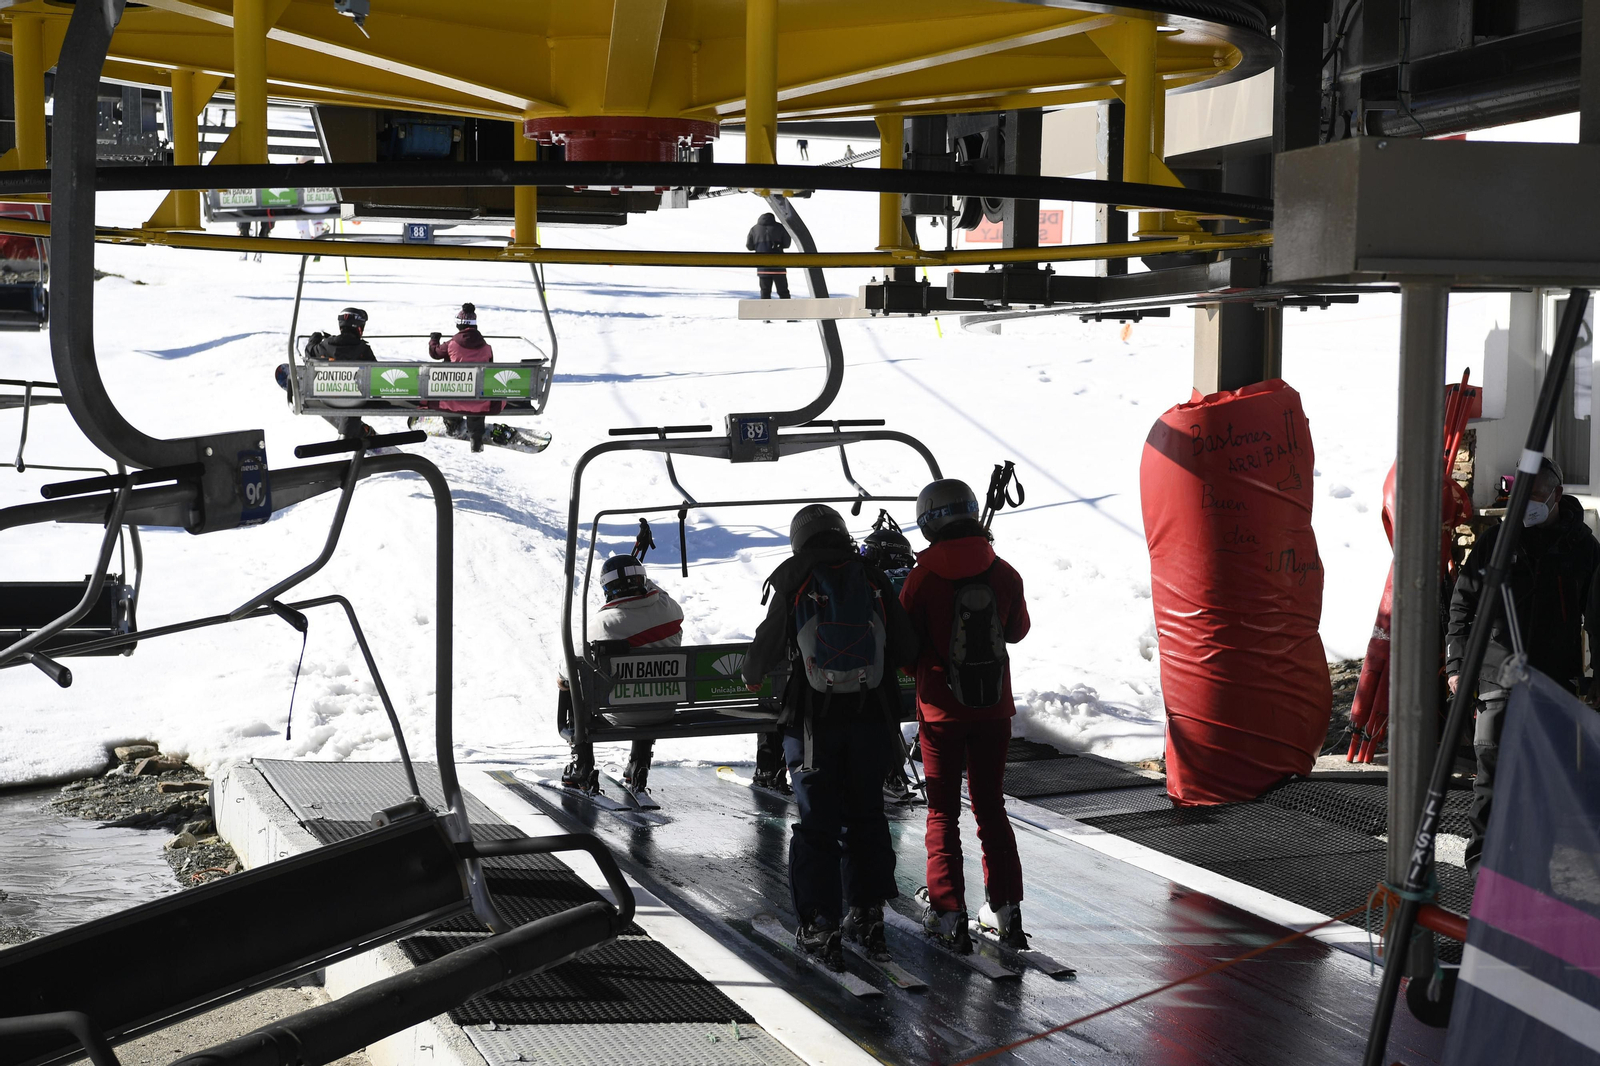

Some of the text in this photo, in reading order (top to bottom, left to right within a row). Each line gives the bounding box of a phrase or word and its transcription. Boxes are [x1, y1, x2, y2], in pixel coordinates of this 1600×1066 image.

[223, 195, 253, 204] DE ALTURA
[413, 226, 424, 237] 88
[317, 371, 352, 381] CONTIGO
[432, 371, 473, 381] CONTIGO A
[316, 382, 325, 392] LO
[431, 383, 439, 392] LO
[456, 383, 473, 392] ALTO
[747, 423, 764, 439] 89
[1190, 423, 1271, 456] Bastones
[1201, 484, 1249, 511] Buen
[616, 660, 679, 679] UN BANCO
[615, 681, 681, 699] DE ALTURA
[711, 686, 736, 694] Unicaja
[1410, 799, 1436, 880] LISKI
